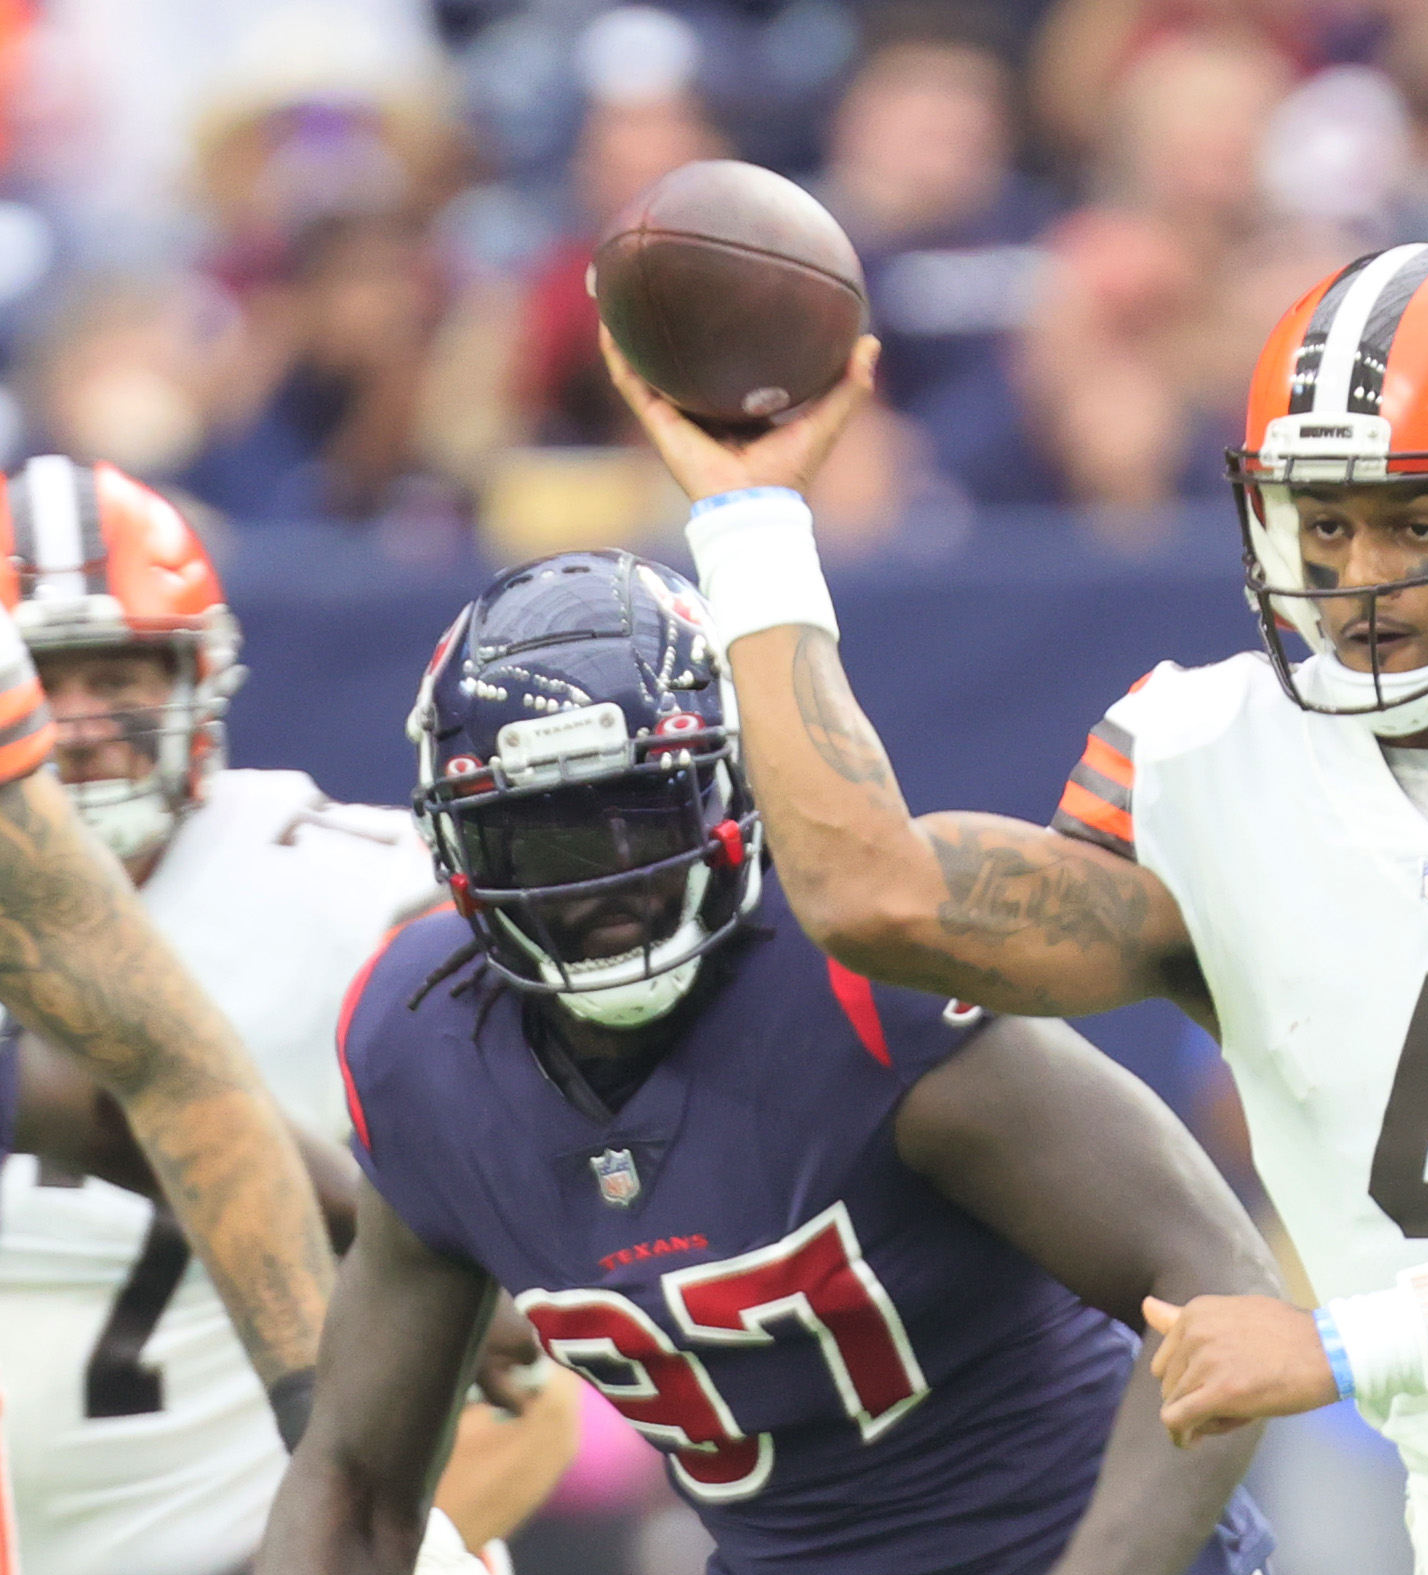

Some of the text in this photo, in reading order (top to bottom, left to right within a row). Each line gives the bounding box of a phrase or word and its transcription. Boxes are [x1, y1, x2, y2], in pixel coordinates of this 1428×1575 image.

[533, 717, 593, 737] TEXANS
[598, 1232, 710, 1271] TEXANS
[514, 1200, 931, 1503] 97
